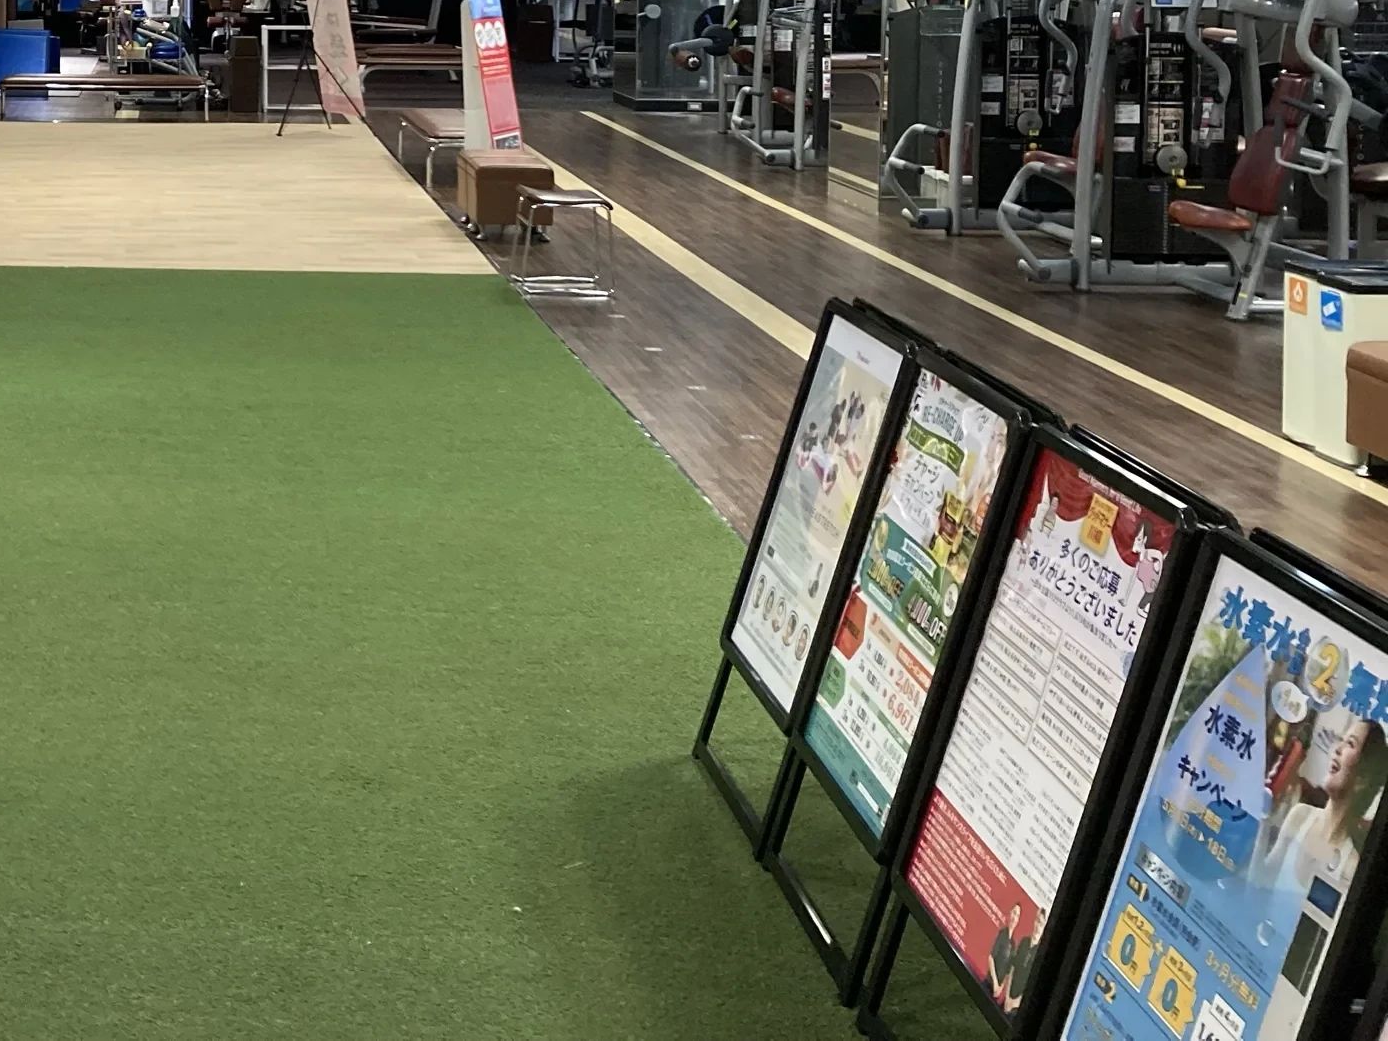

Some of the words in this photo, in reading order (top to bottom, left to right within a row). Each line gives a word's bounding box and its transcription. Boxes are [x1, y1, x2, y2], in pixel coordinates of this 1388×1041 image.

[1028, 549, 1138, 647] ありがとうございました
[1058, 538, 1121, 598] 多くのご応募
[1204, 704, 1256, 761] 水素水
[1178, 754, 1249, 823] キャンペーン
